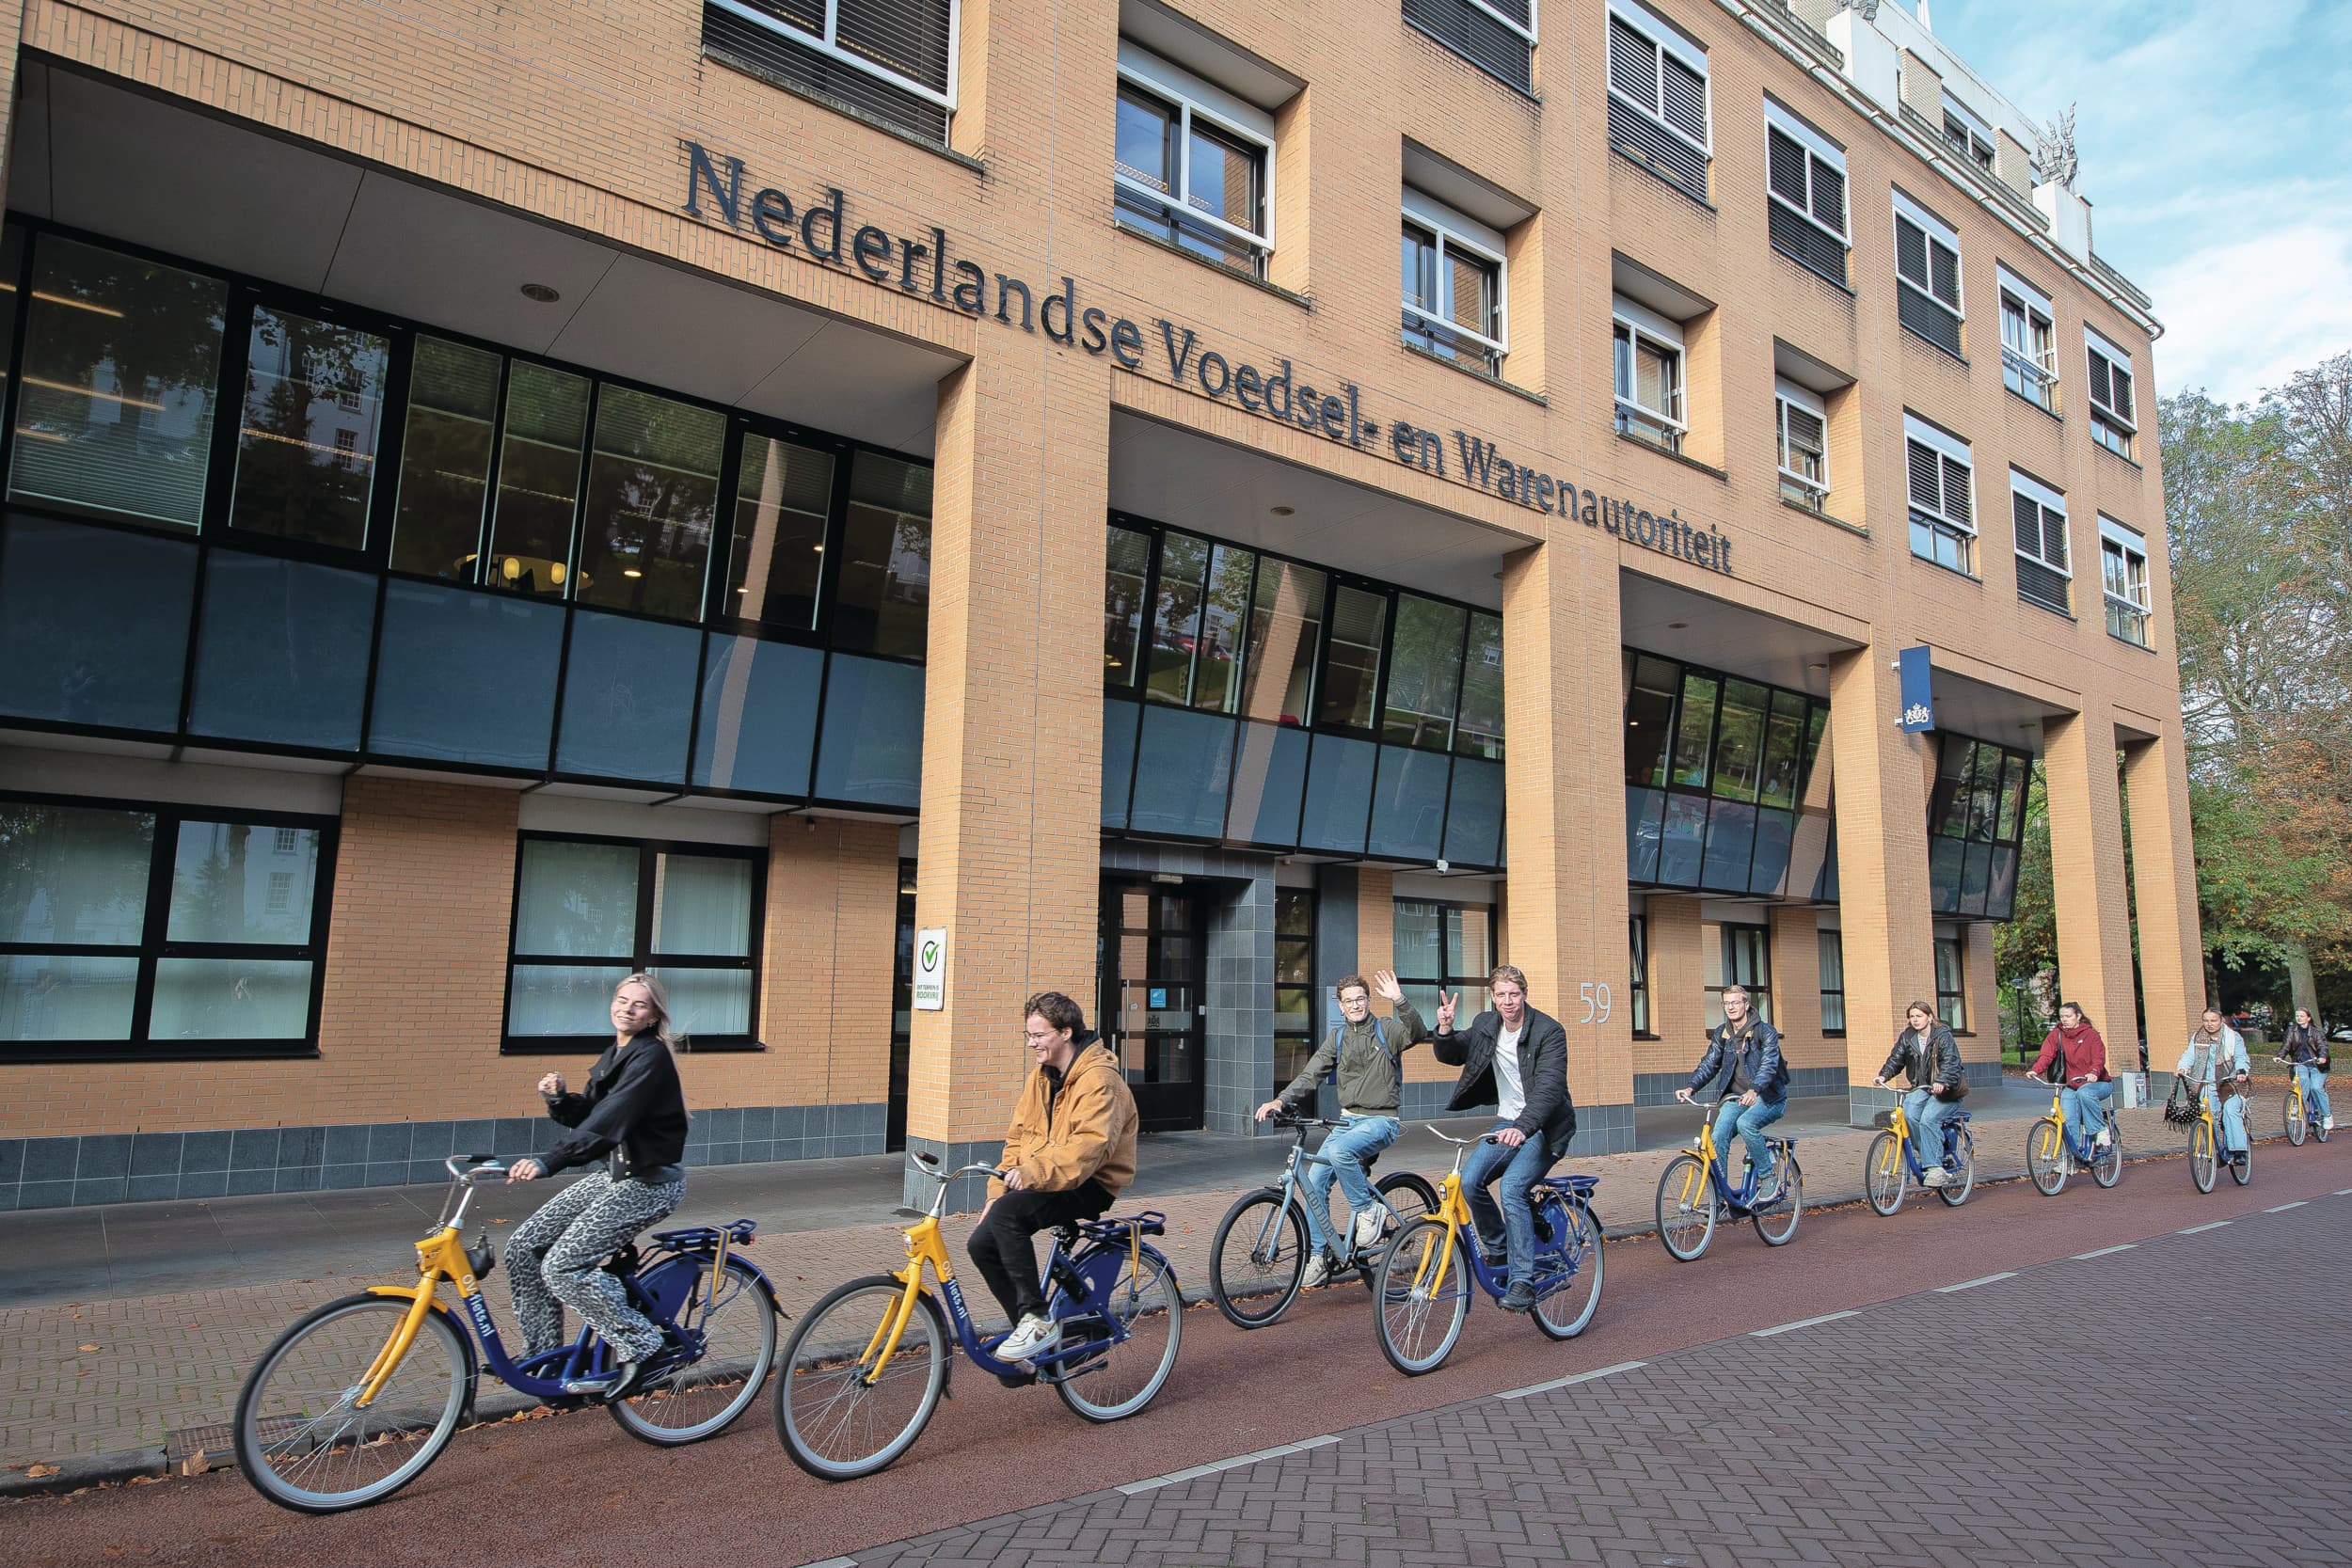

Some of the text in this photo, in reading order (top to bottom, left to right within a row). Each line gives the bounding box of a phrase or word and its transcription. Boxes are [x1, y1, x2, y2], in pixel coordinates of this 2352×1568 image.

[681, 139, 1732, 573] Nederlandse Voedsel- en Warenautoriteit
[1581, 982, 1611, 1023] 59
